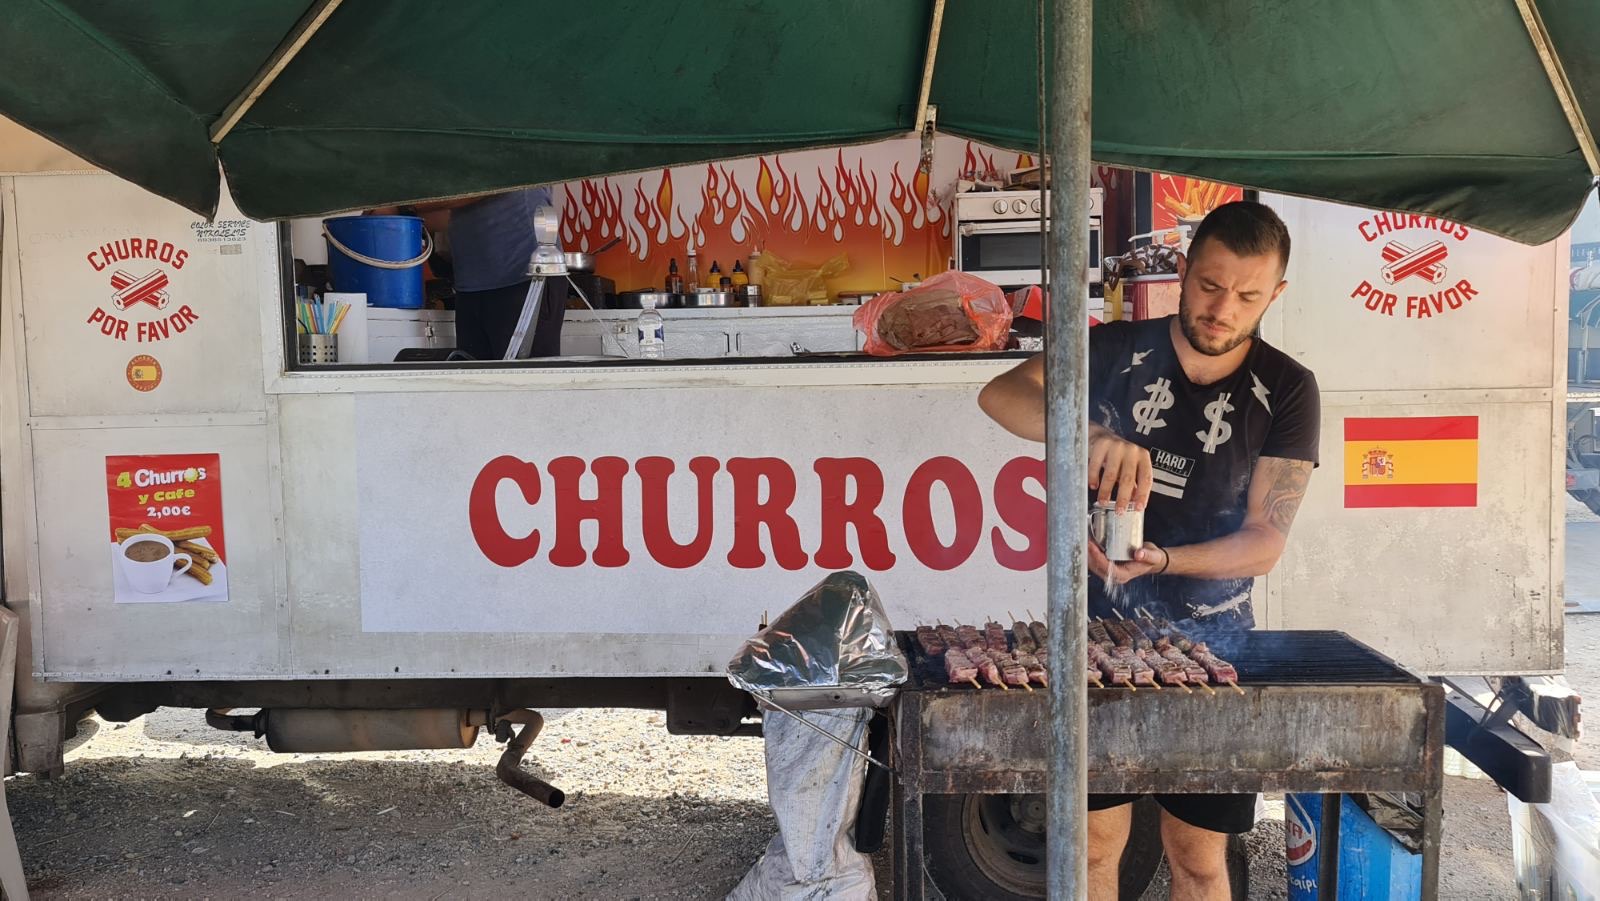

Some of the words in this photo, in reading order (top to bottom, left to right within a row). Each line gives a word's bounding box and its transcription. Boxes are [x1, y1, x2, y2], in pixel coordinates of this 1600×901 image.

[217, 219, 251, 229] SERVICE
[1358, 211, 1469, 242] CHURROS
[87, 238, 189, 272] CHURROS
[1351, 280, 1398, 316] POR
[1406, 279, 1479, 319] FAVOR
[87, 307, 129, 341] POR
[137, 304, 199, 342] FAVOR
[1155, 450, 1187, 470] HARD
[116, 471, 132, 488] 4
[134, 467, 207, 487] Churros
[138, 494, 149, 504] y
[154, 488, 196, 501] cafe
[147, 505, 191, 519] 2,00€
[469, 455, 1048, 571] CHURROS
